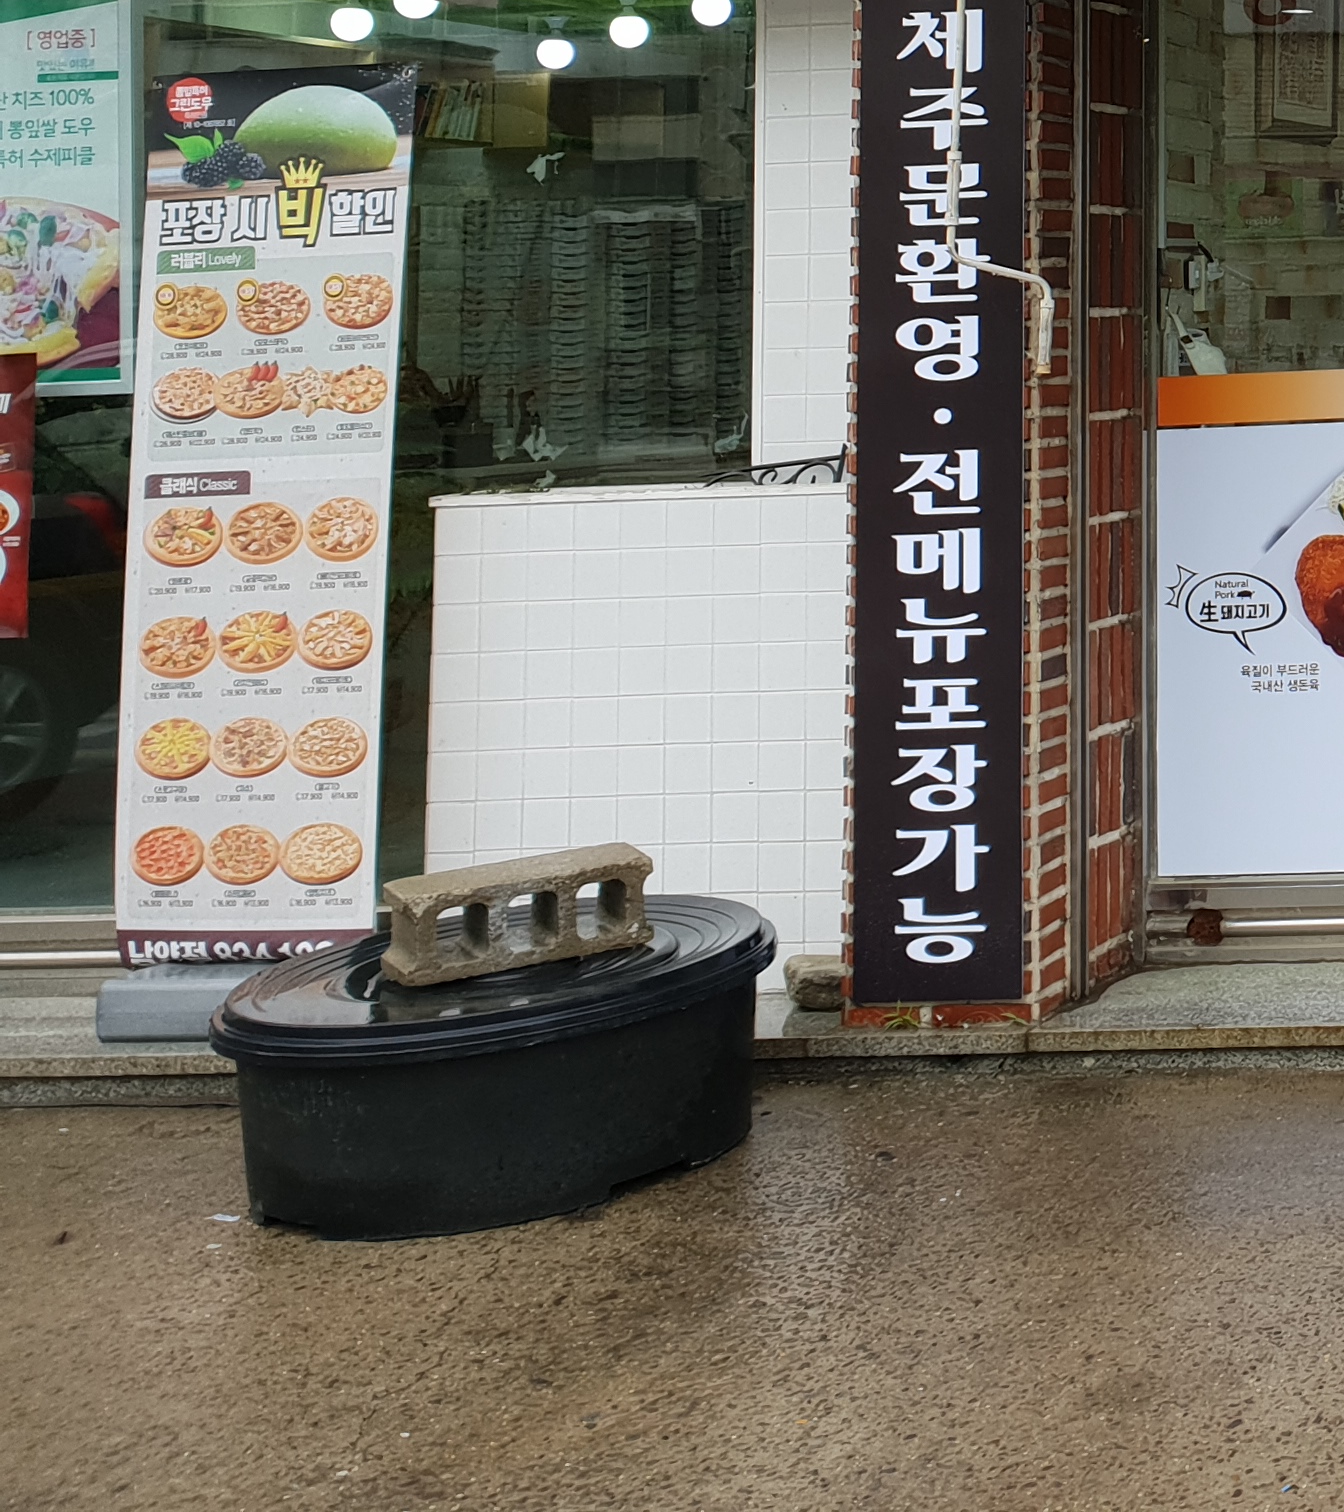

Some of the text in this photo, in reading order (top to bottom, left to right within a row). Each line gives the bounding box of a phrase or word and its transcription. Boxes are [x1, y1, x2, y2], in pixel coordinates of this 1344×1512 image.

[12, 91, 45, 110] 치즈
[49, 88, 95, 107] 100%
[61, 117, 95, 136] 도우
[28, 146, 96, 168] 수제피클
[159, 199, 226, 246] 포장
[277, 186, 326, 247] 빅
[329, 187, 397, 237] 할인
[208, 252, 242, 268] Lovely
[199, 478, 238, 492] Classic
[1214, 579, 1249, 589] Natural
[1214, 590, 1236, 599] Pork
[1221, 603, 1270, 620] 돼지고기
[1241, 662, 1320, 678] 육질이 부드러운
[1251, 680, 1284, 693] 국내산
